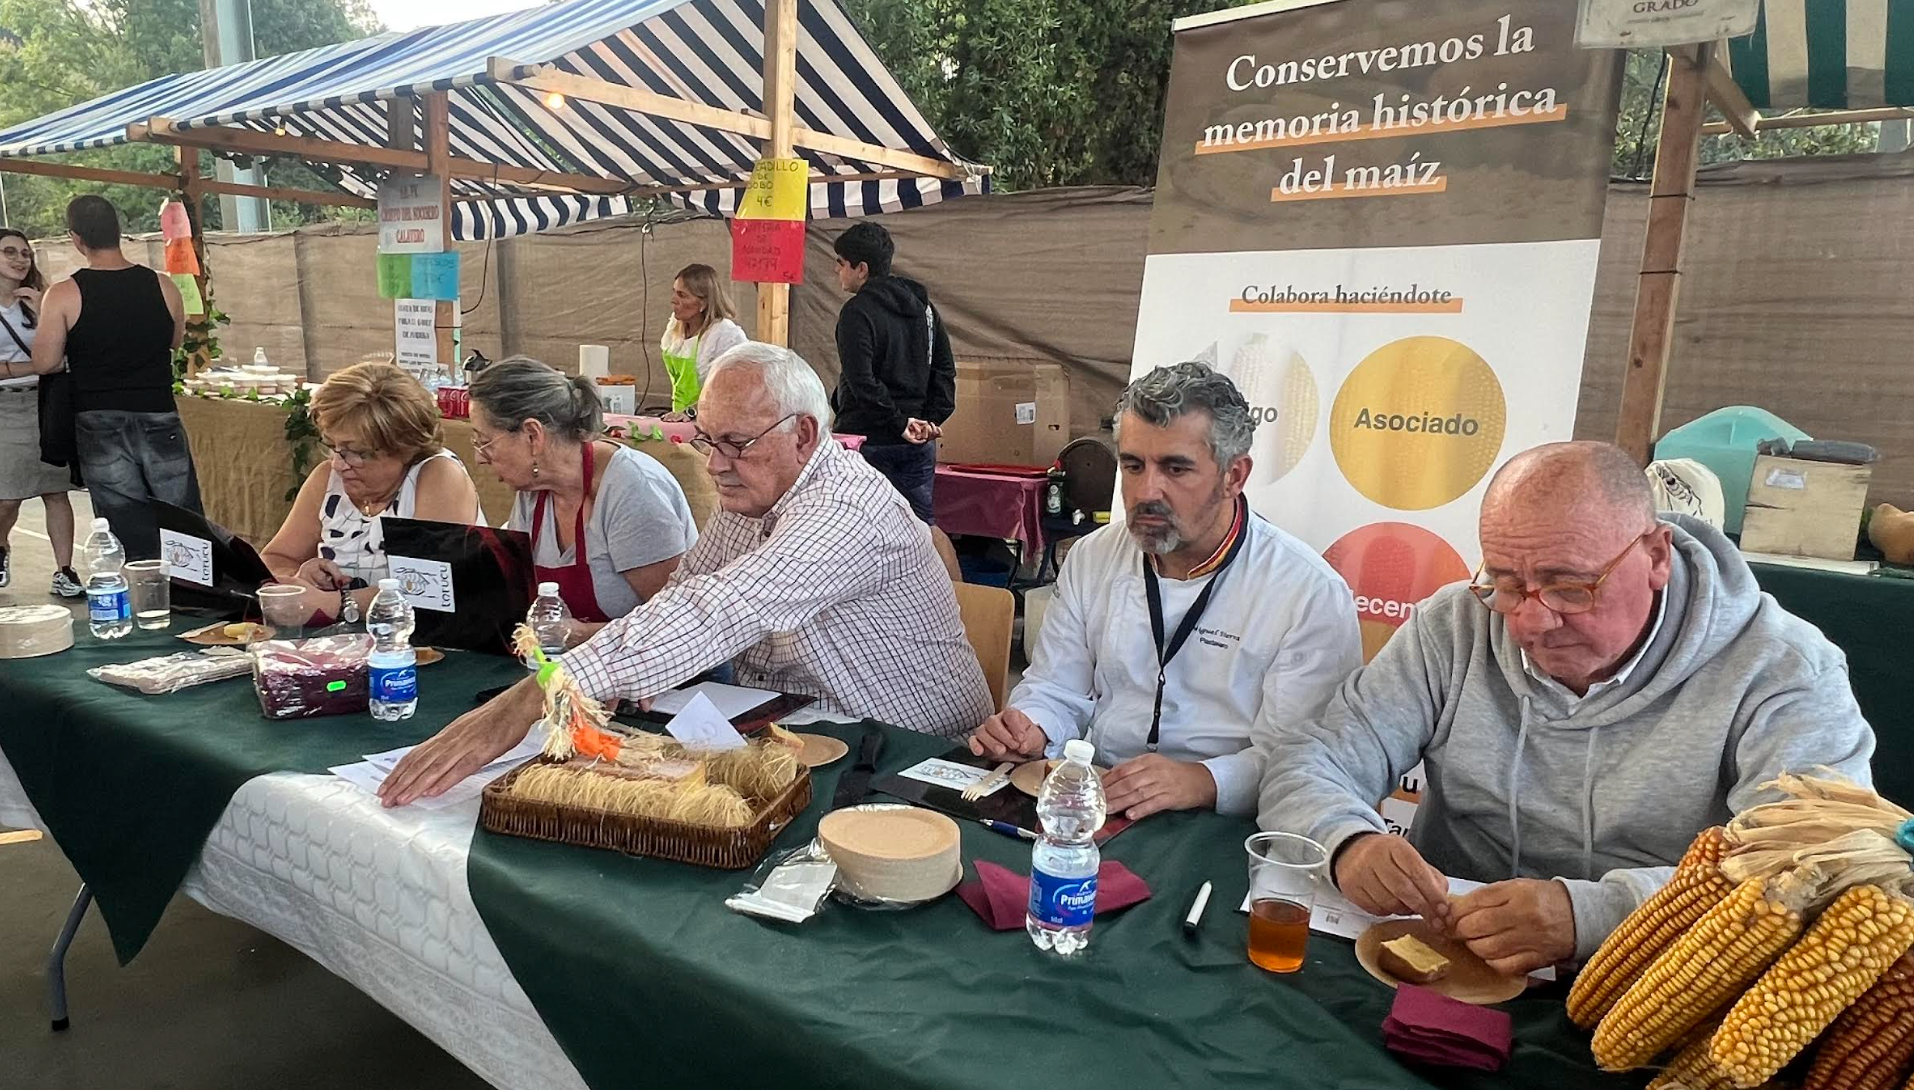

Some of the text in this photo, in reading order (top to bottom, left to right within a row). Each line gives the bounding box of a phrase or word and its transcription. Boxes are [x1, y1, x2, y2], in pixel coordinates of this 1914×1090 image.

[1633, 0, 1698, 13] GRADO
[1226, 13, 1535, 92] Conservemos la
[1201, 82, 1558, 148] memoria histórica
[1279, 151, 1443, 195] del maíz
[756, 195, 773, 207] 4€
[1241, 283, 1452, 304] Colabora haciéndote
[1250, 405, 1278, 426] go
[1353, 408, 1479, 437] Asociado
[1351, 590, 1416, 618] ecen
